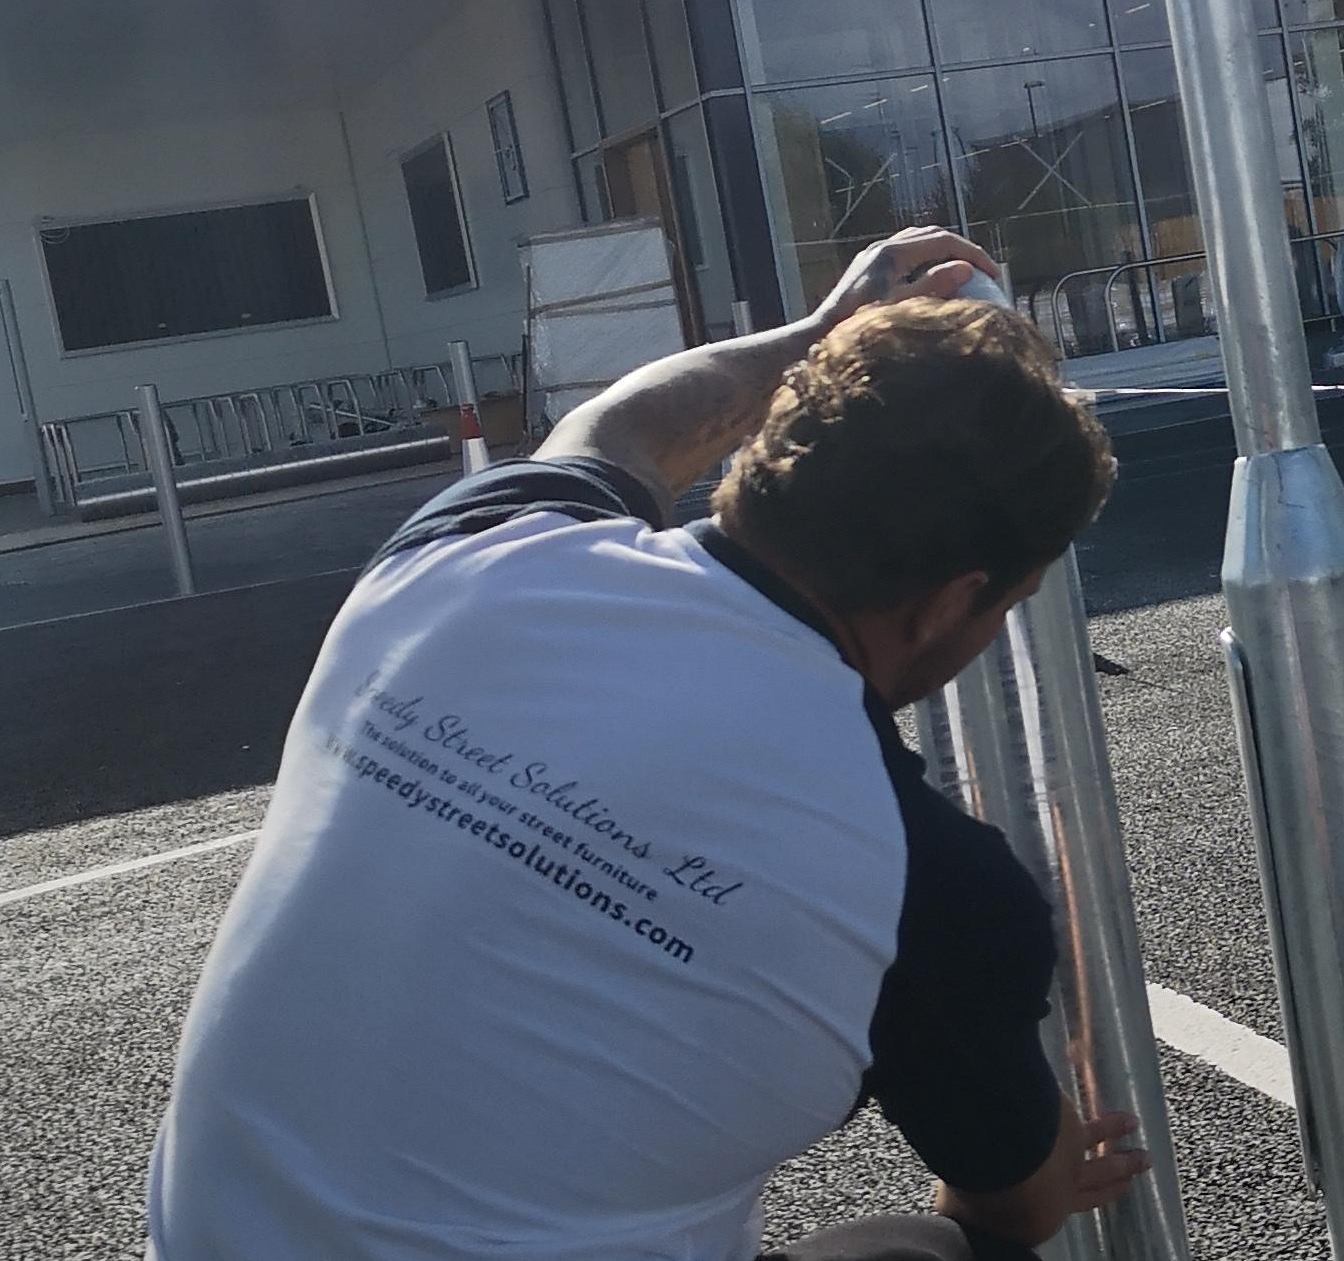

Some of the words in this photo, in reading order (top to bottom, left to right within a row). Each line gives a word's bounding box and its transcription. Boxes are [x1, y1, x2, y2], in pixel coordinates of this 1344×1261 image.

[379, 736, 439, 776] solution
[439, 769, 458, 785] to
[458, 781, 482, 797] all
[476, 791, 518, 816] your
[518, 811, 574, 849] street
[573, 842, 658, 902] furniture
[424, 715, 513, 774] Street
[509, 762, 652, 859] Solutions
[662, 854, 744, 906] Ltd
